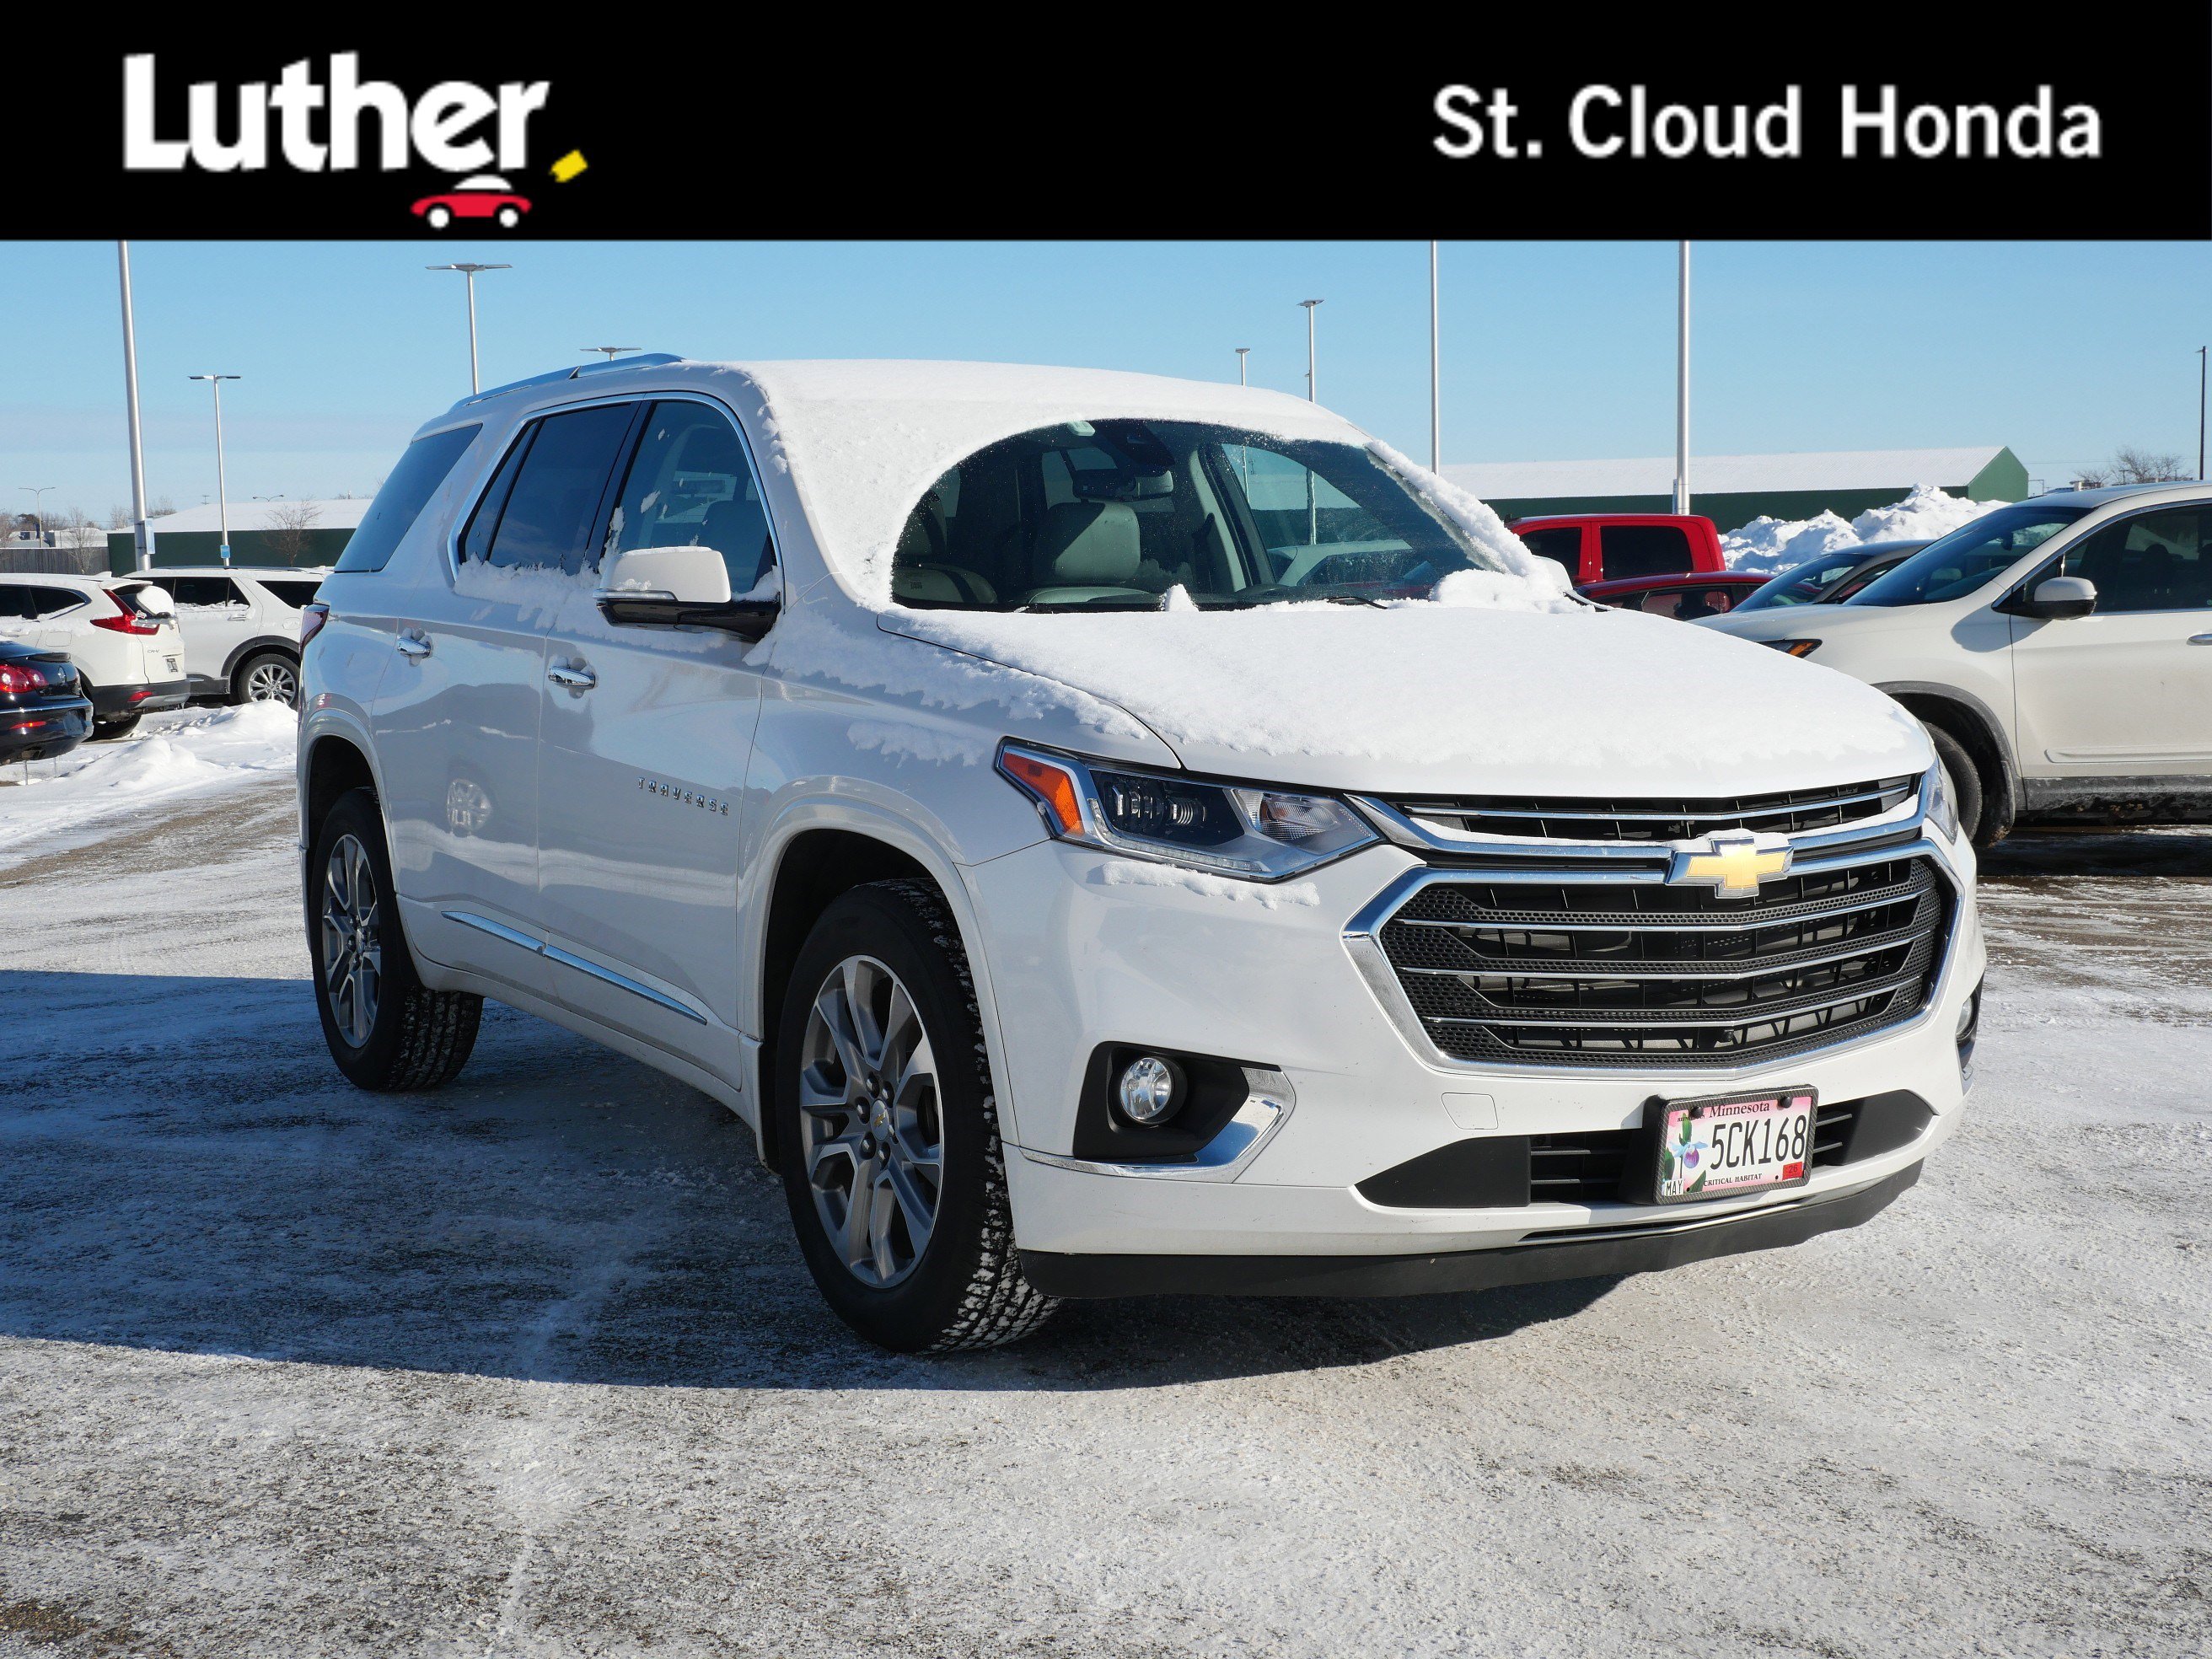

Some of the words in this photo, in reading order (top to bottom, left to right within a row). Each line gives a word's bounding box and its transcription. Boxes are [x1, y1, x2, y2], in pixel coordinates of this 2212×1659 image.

[637, 776, 729, 817] TRAVERSE
[1709, 1102, 1770, 1119] Minnesota
[1710, 1114, 1807, 1170] 5CK168
[1788, 1164, 1798, 1173] 26
[1666, 1180, 1683, 1196] MAY
[1704, 1178, 1732, 1187] CRITICAL
[1735, 1173, 1763, 1183] HABITAT
